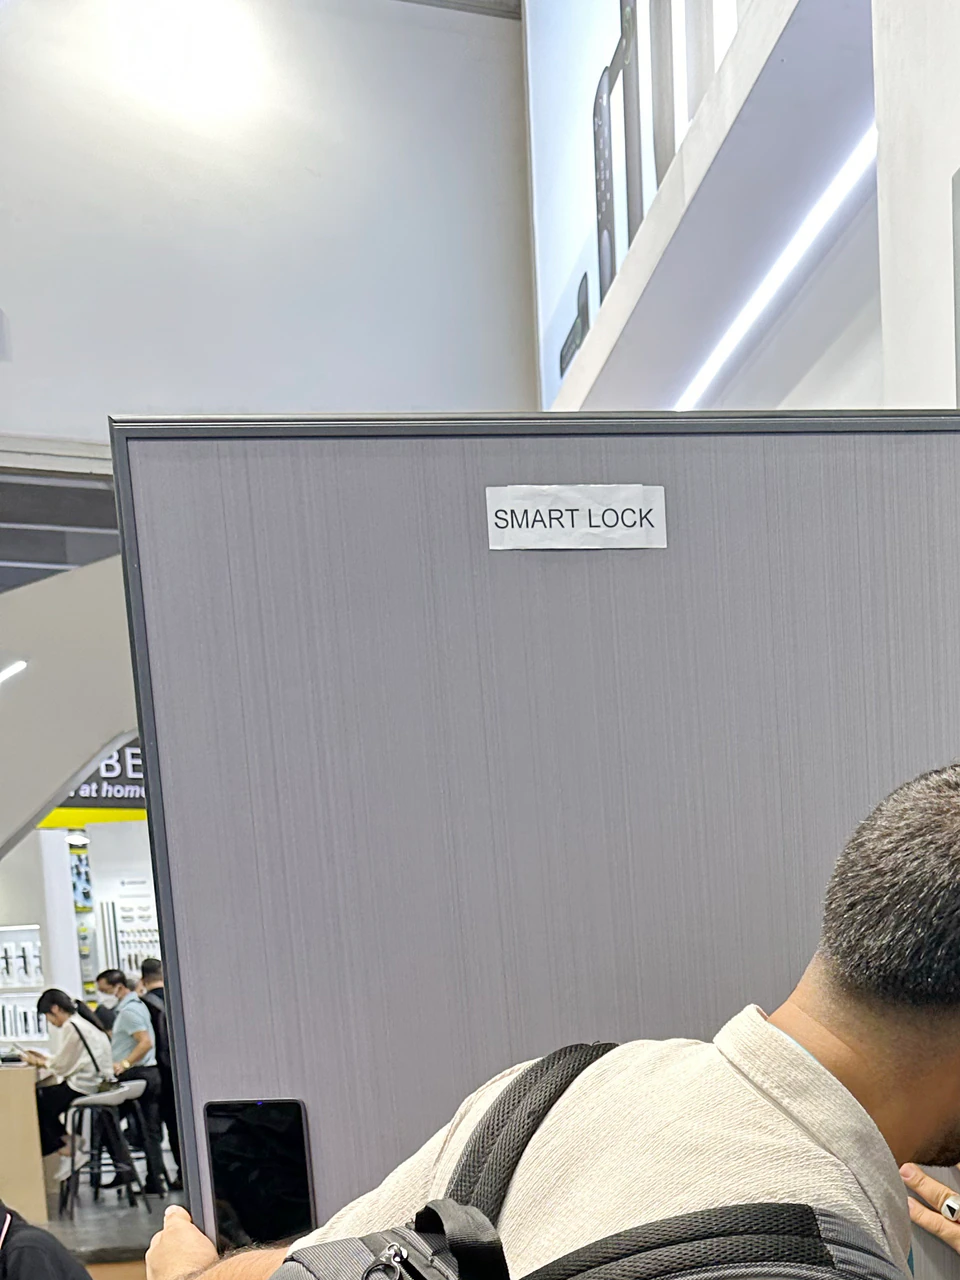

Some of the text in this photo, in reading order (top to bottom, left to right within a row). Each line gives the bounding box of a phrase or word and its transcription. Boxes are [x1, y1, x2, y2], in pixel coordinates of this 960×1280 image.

[494, 508, 655, 529] SMART LOCK
[79, 782, 98, 798] at
